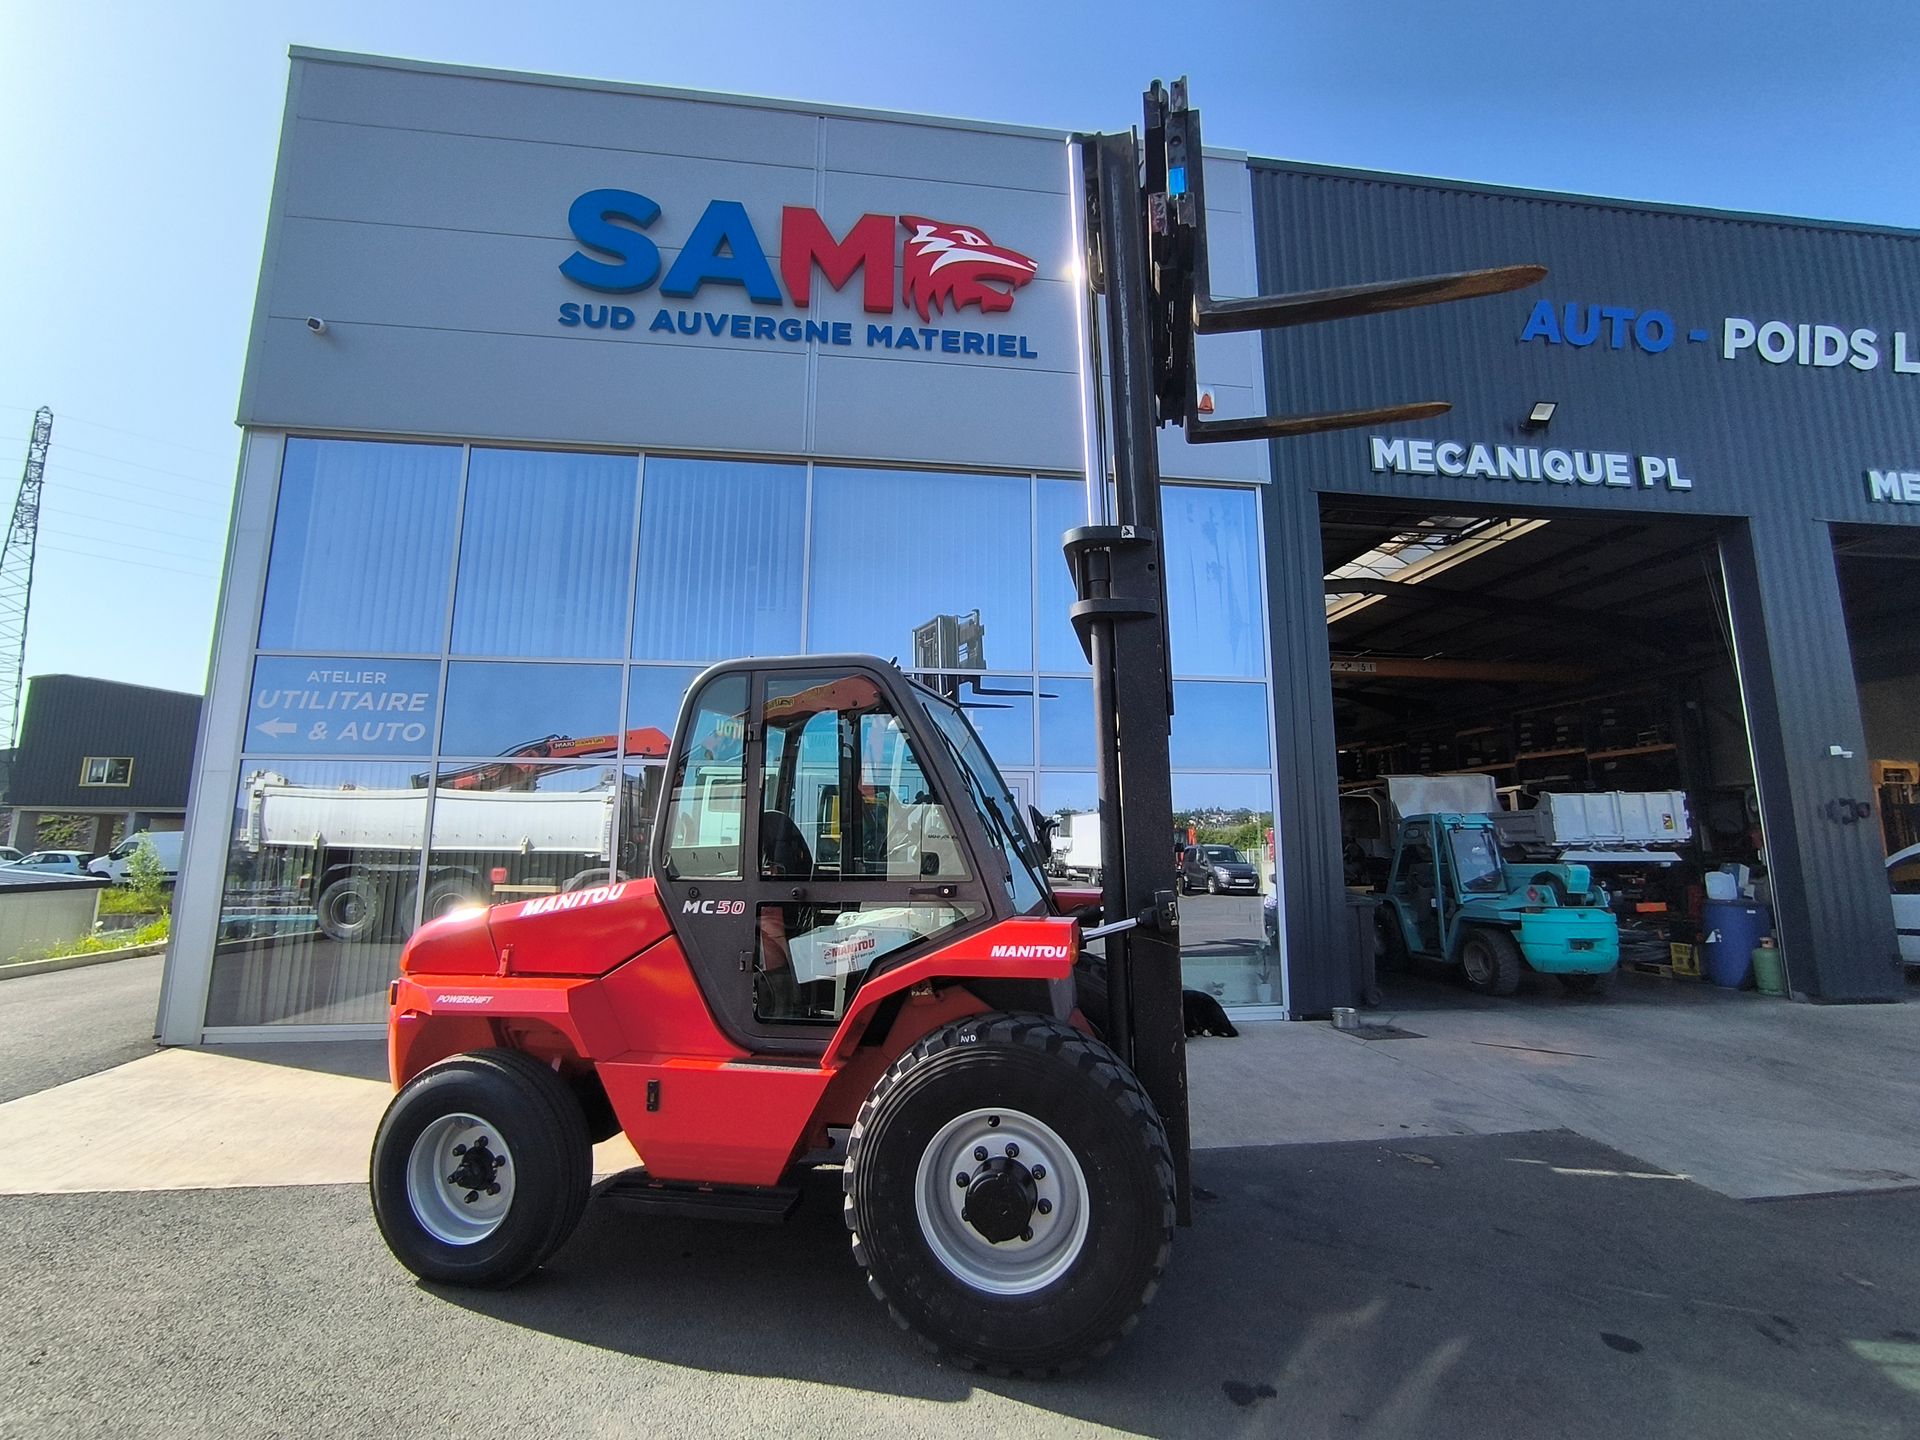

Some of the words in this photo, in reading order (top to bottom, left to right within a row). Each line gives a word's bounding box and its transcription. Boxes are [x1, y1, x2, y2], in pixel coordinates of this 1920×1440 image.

[559, 188, 896, 314] SAM
[558, 302, 635, 331] SUD
[649, 308, 852, 346] AUVERGNE
[867, 324, 1038, 359] MATERIEL
[1521, 300, 1676, 353] AUTO
[1723, 317, 1879, 371] POIDS
[1371, 436, 1632, 487] MECANIQUE
[1640, 455, 1692, 490] PL
[1868, 469, 1920, 503] ME
[307, 670, 387, 684] ATELIER
[256, 689, 429, 712] UTILITAIRE
[308, 721, 328, 741] &
[336, 722, 426, 742] AUTO
[520, 884, 627, 917] MANITOU
[831, 938, 876, 957] MANITOU
[991, 945, 1068, 958] MANITOU
[436, 994, 494, 1004] POWERSHIFT
